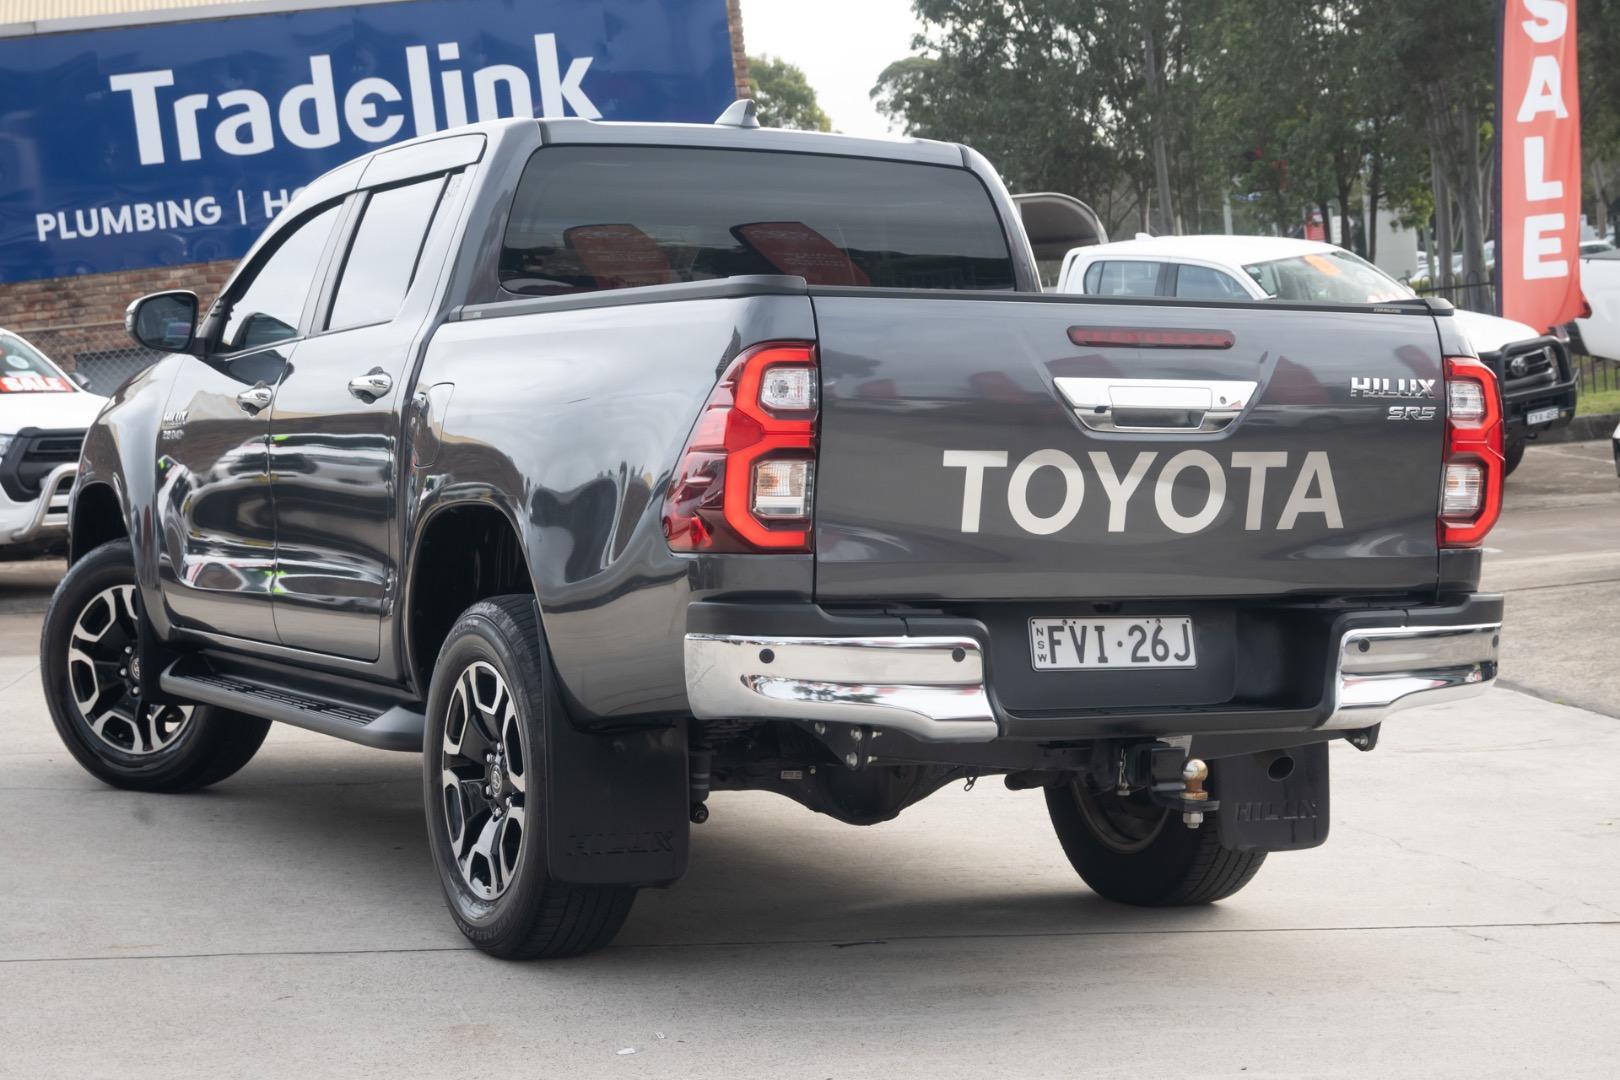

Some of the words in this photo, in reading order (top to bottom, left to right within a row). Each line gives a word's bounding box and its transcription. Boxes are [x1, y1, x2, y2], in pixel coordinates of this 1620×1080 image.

[110, 33, 603, 165] Tradelink
[1517, 0, 1569, 281] SALE
[36, 196, 222, 242] PLUMBING
[263, 186, 306, 218] H
[1350, 377, 1436, 399] HILUX
[1387, 406, 1437, 420] SR5
[943, 449, 1344, 535] TOYOTA
